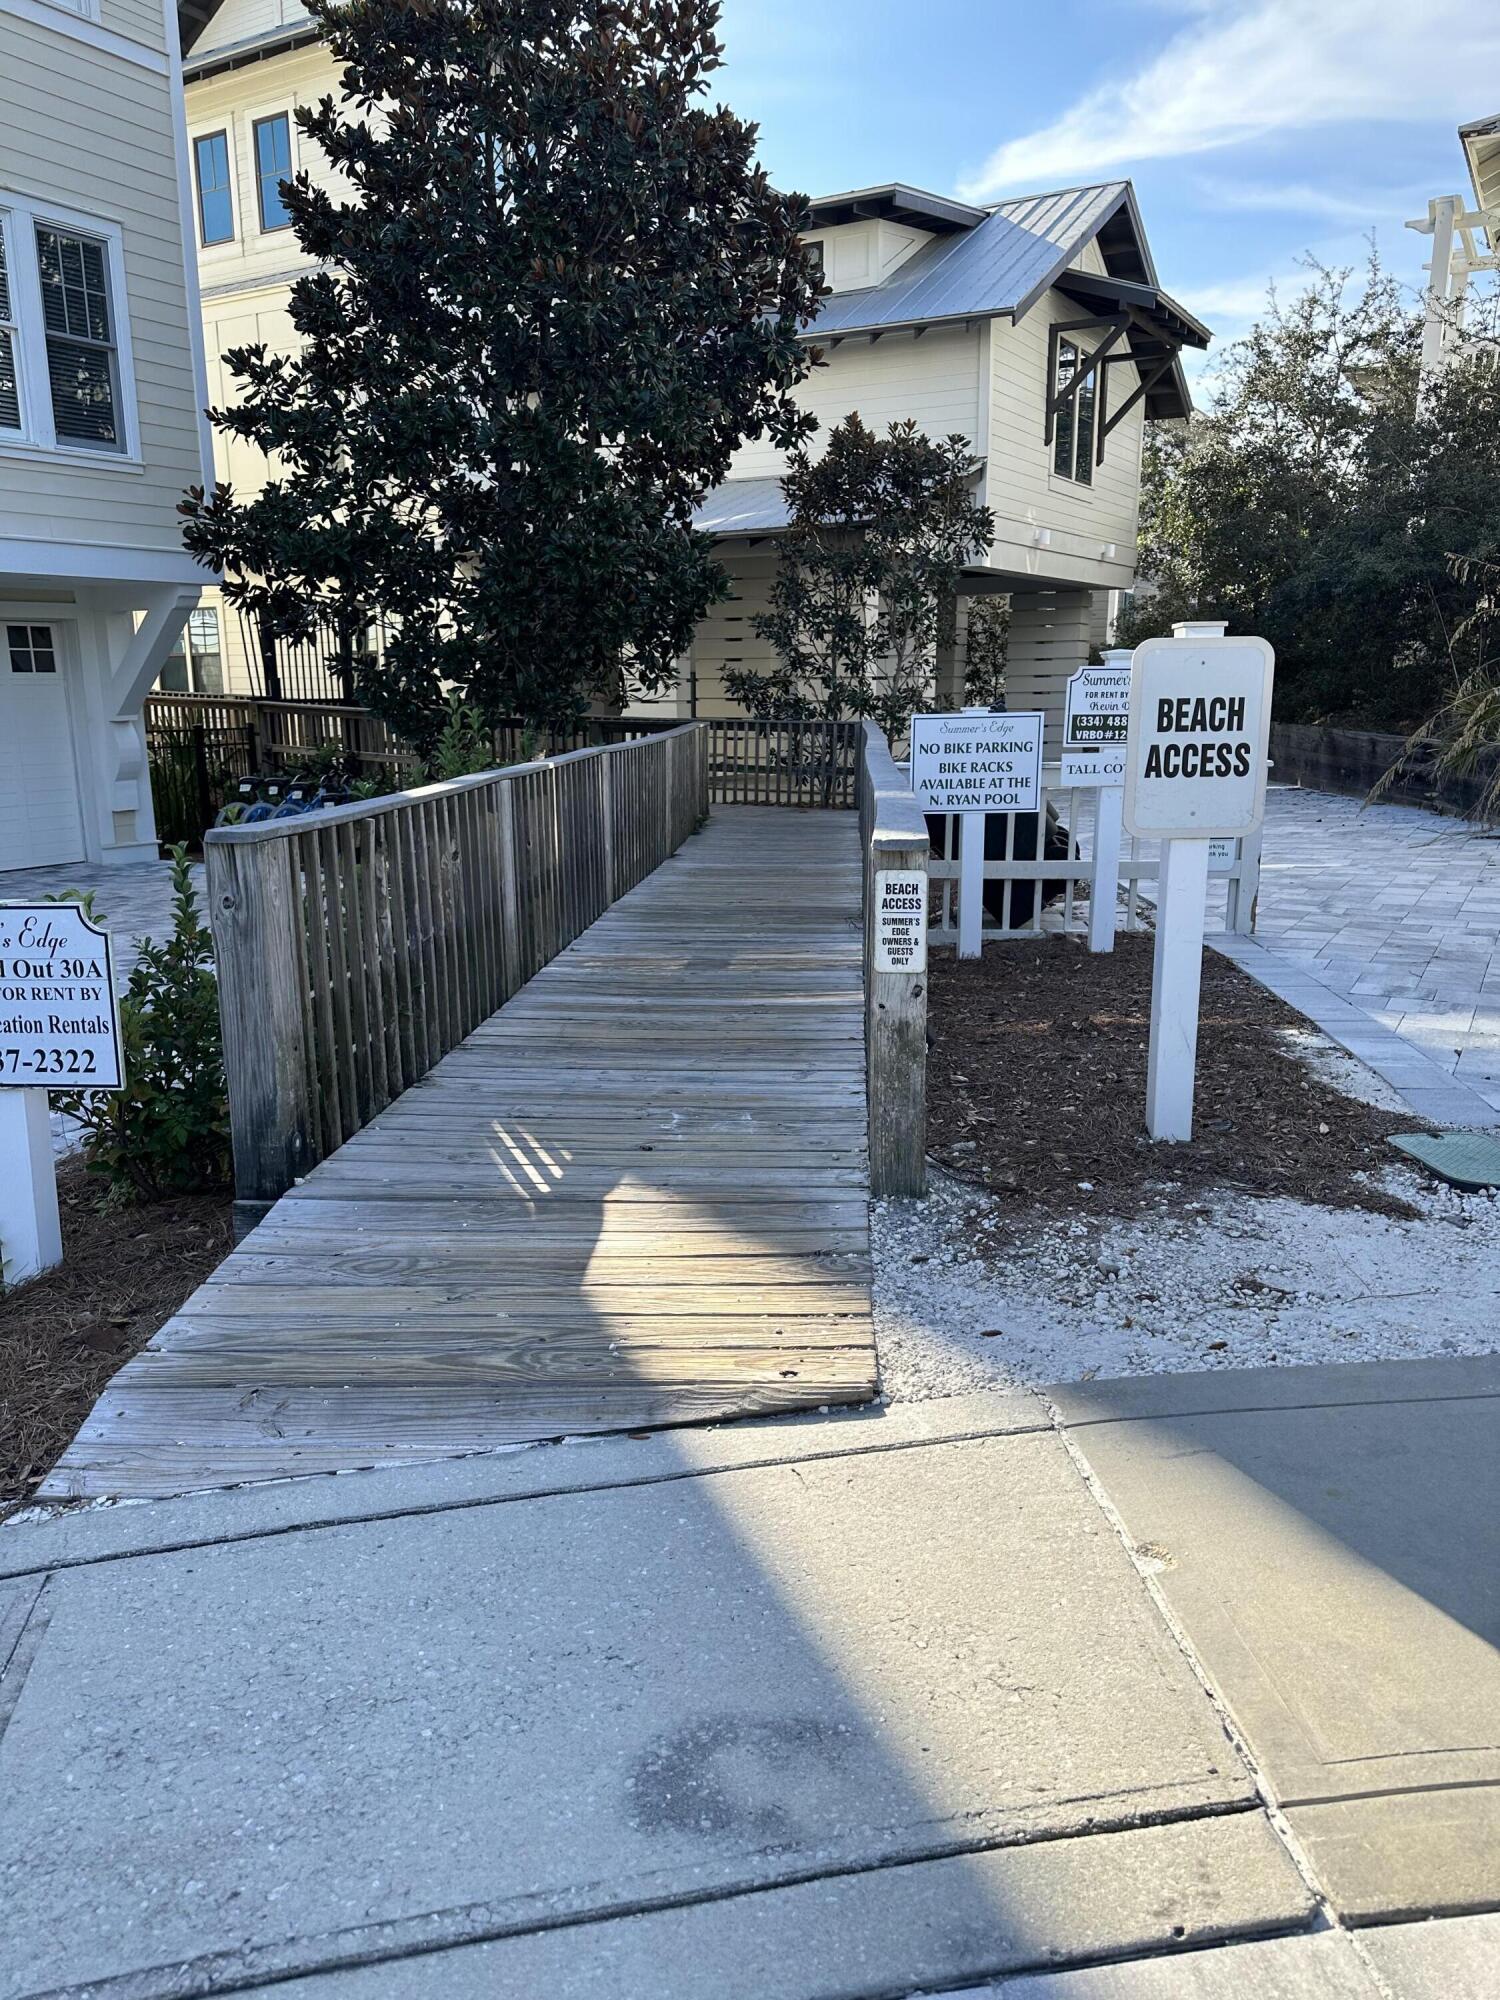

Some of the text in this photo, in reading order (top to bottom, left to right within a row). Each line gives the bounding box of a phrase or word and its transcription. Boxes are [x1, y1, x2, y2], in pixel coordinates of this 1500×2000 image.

[1089, 702, 1119, 711] Kevin
[1076, 716, 1128, 726] (334) 488
[1157, 697, 1245, 732] BEACH
[940, 720, 1015, 737] Summer's Edge
[919, 741, 1033, 754] NO BIKE PARKING
[1144, 742, 1251, 778] ACCESS
[939, 761, 1013, 774] BIKE RACKS
[1067, 764, 1100, 775] TALL
[920, 777, 1031, 790] AVAILABLE AT THE
[930, 793, 1020, 806] N. RYAN POOL
[885, 883, 919, 895] BEACH
[881, 898, 922, 910] ACCESS
[882, 918, 920, 926] SUMMER'S
[18, 916, 68, 958] Edge
[892, 928, 910, 936] EDGE
[882, 938, 919, 946] OWNERS &
[887, 948, 914, 956] GUESTS
[13, 959, 54, 978] Out
[60, 959, 103, 978] 30A
[891, 958, 909, 966] ONLY
[0, 987, 102, 1001] OR RENT BY
[48, 1015, 110, 1034] Rentals
